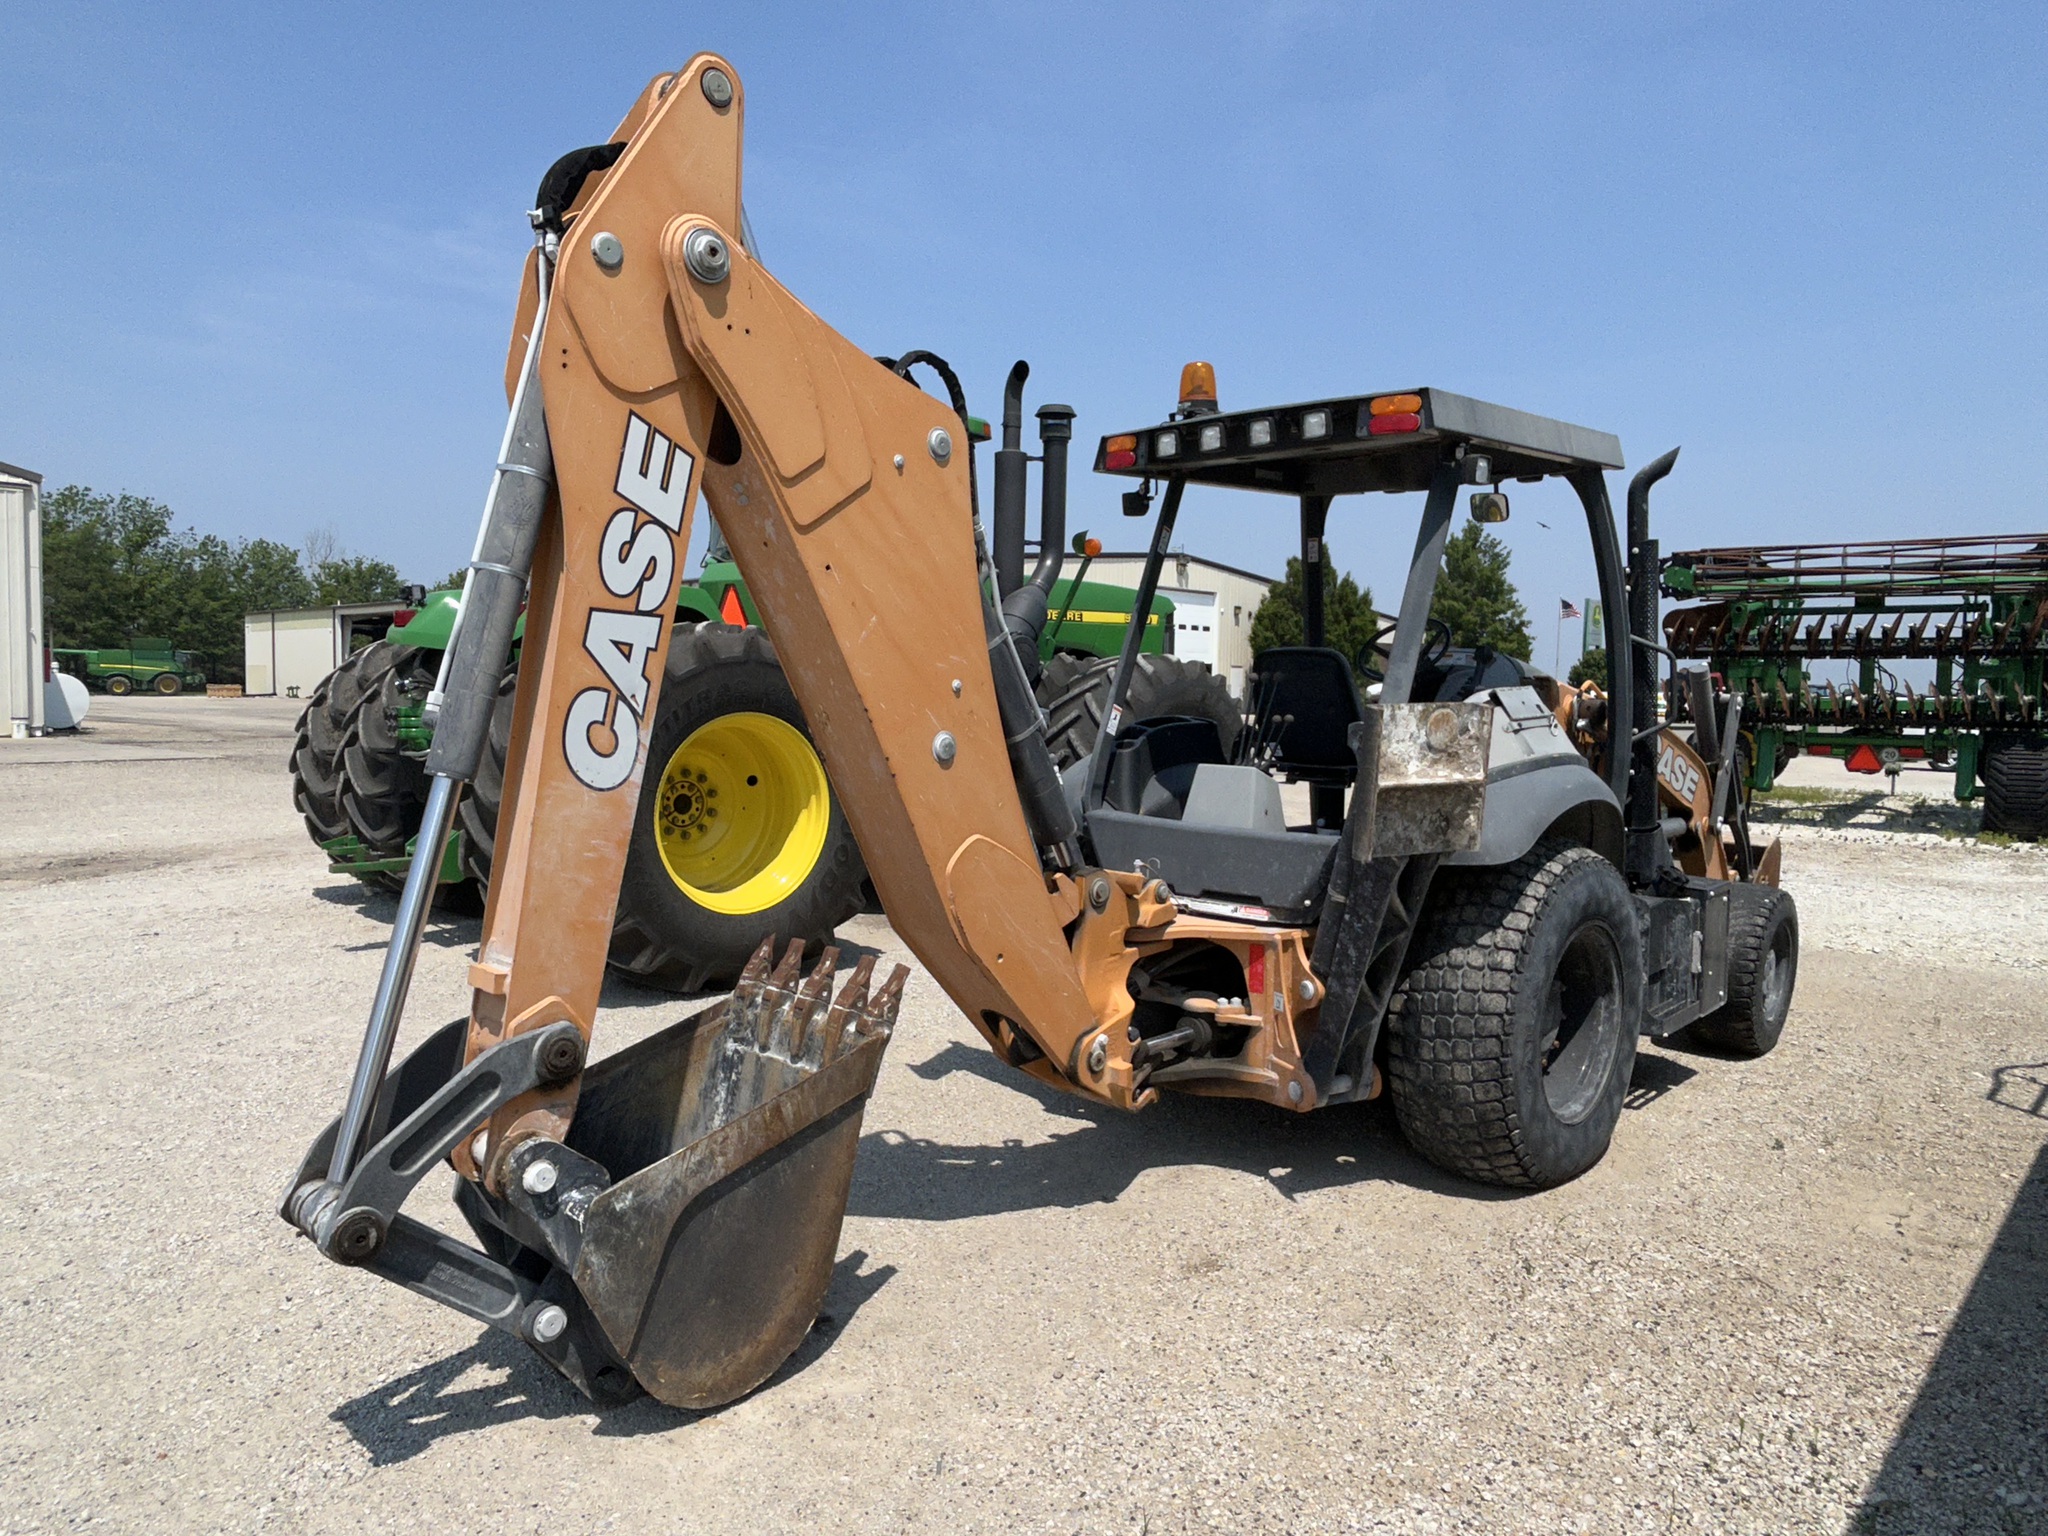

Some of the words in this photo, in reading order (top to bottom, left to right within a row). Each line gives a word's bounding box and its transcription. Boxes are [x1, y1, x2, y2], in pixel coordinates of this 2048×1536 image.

[562, 408, 695, 792] CASE
[1046, 609, 1081, 621] DERE
[1657, 734, 1700, 804] ASE
